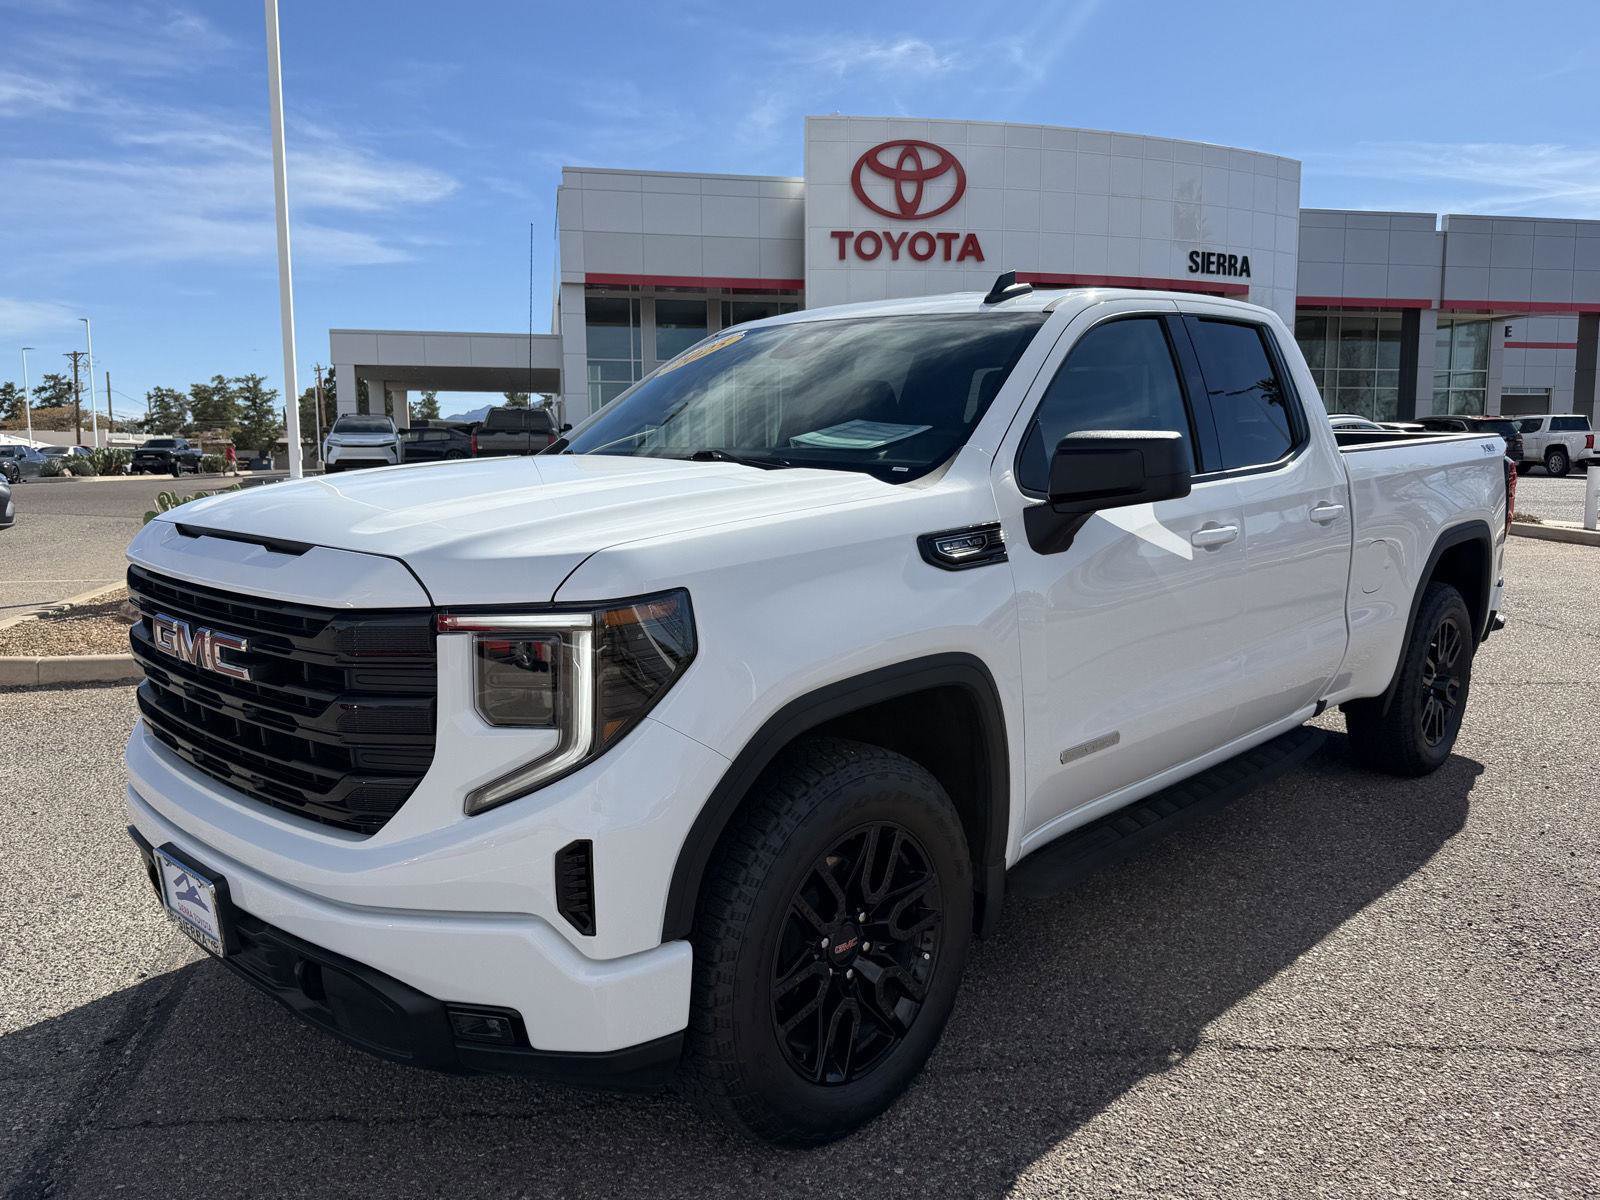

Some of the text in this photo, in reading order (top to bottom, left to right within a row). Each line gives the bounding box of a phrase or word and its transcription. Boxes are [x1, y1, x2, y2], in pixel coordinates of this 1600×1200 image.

[830, 230, 985, 262] TOYOTA
[1188, 250, 1251, 278] SIERRA
[153, 612, 250, 681] GMC
[834, 936, 858, 954] GMC
